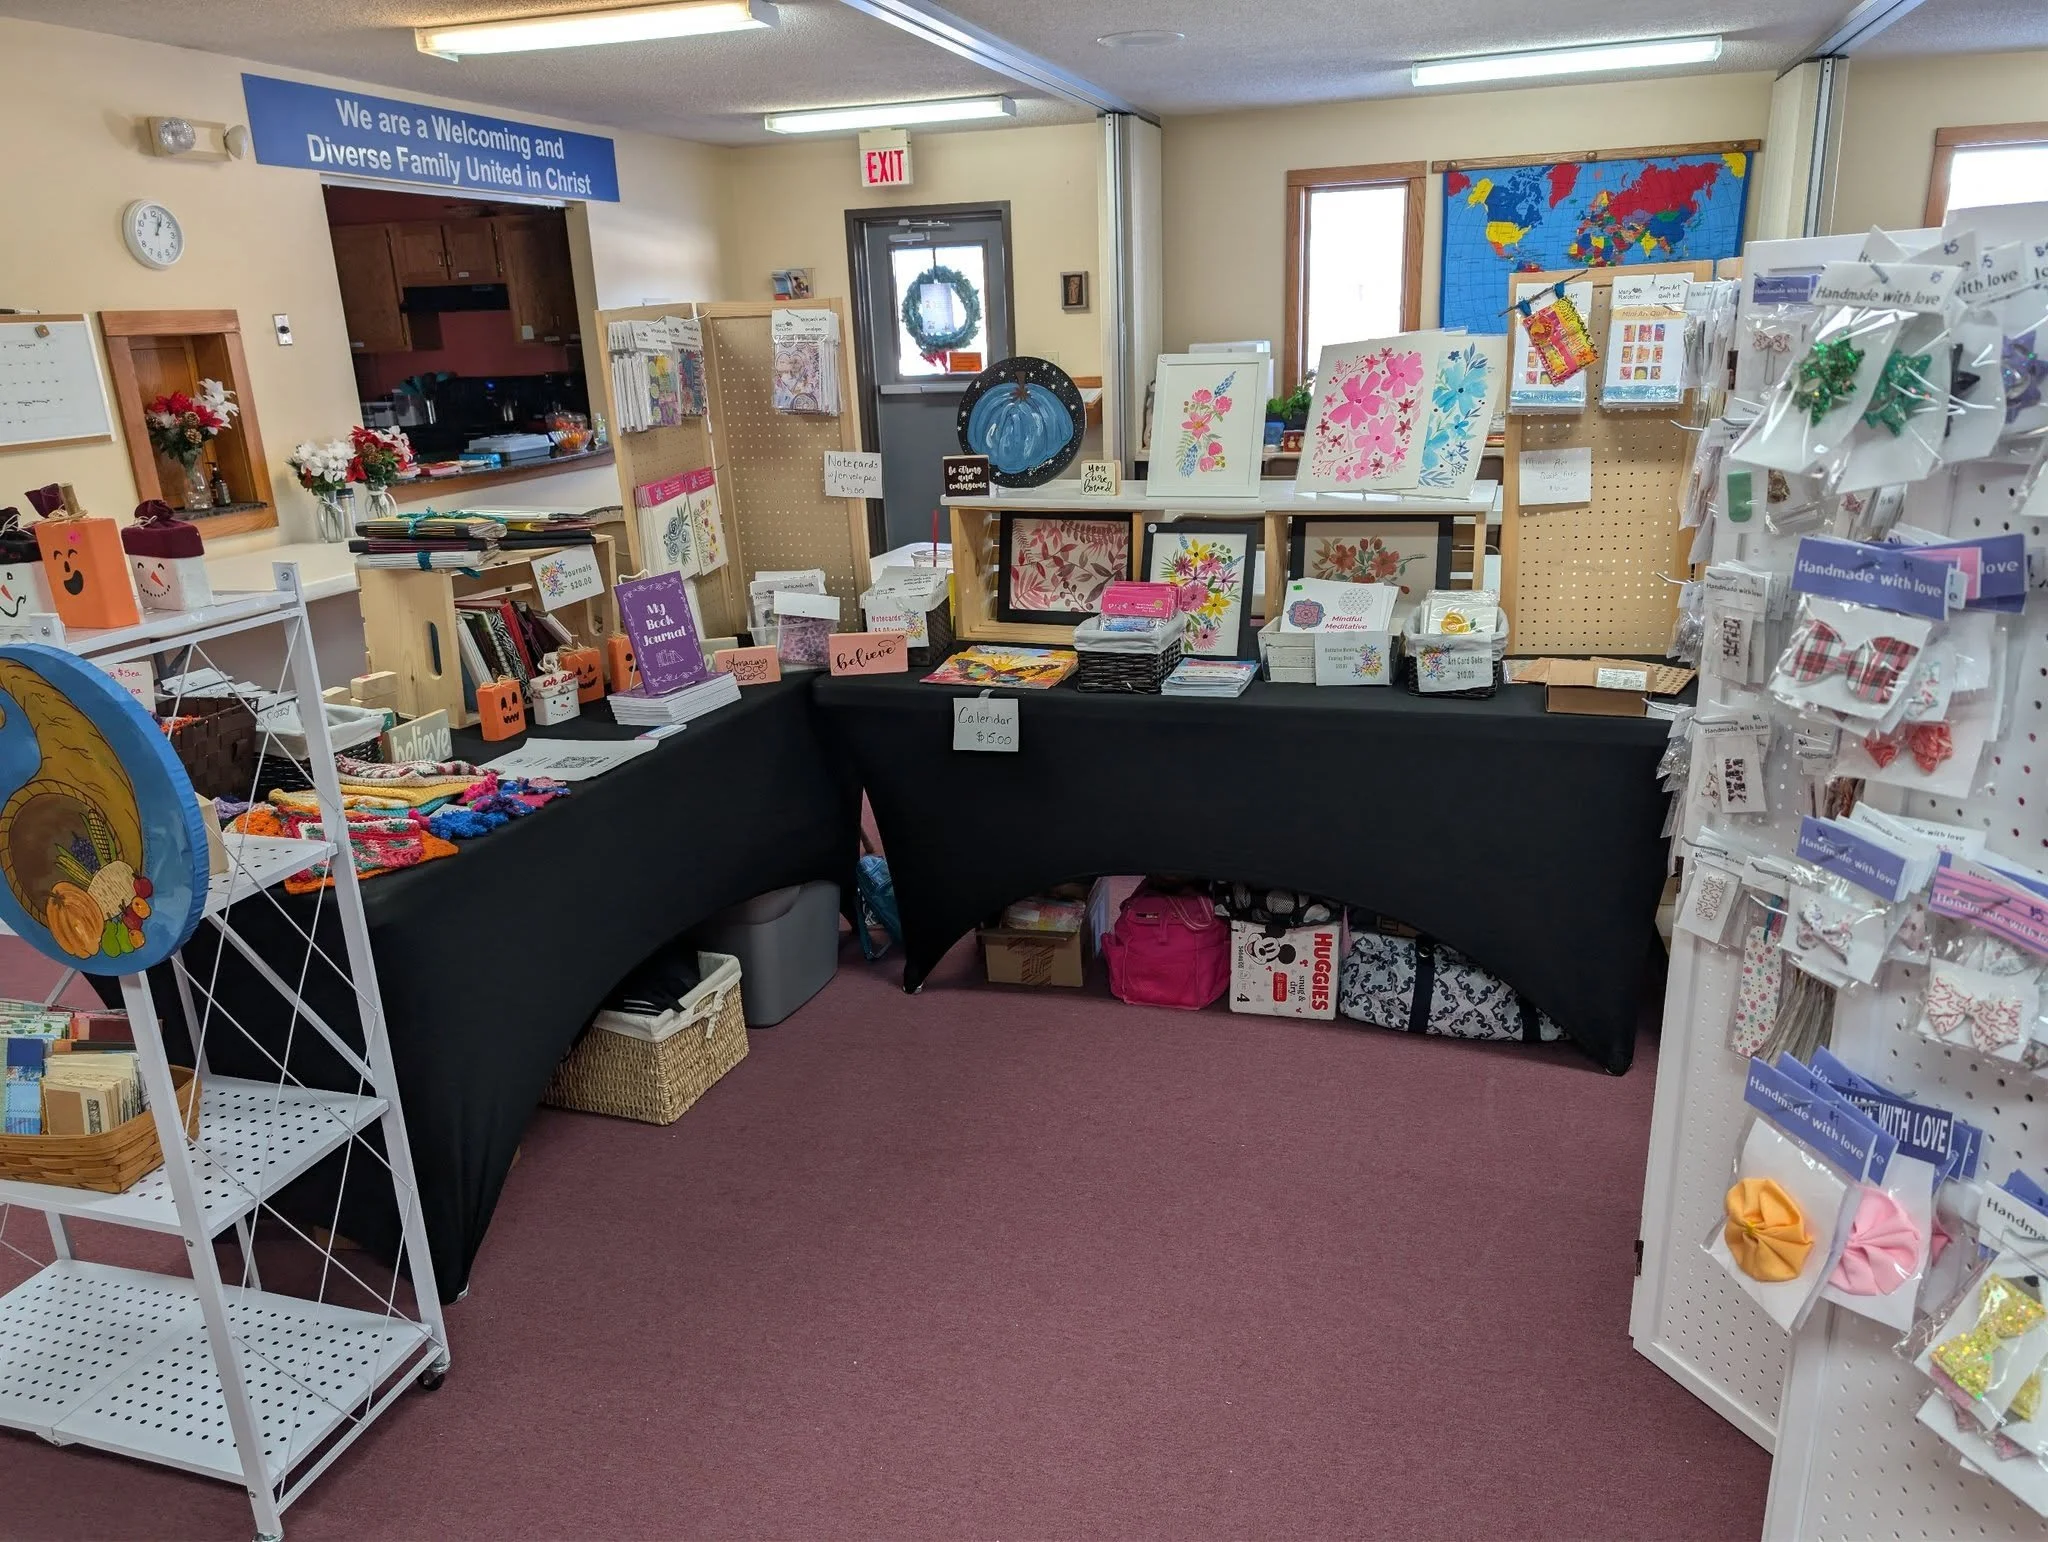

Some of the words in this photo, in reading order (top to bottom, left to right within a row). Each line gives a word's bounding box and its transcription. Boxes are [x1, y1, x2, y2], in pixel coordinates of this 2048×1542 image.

[336, 98, 373, 130] We
[378, 111, 411, 137] are
[416, 118, 428, 139] a
[430, 114, 531, 160] Welcoming
[535, 137, 565, 160] and
[306, 133, 392, 171] Diverse
[396, 145, 460, 185] Family
[466, 160, 521, 187] United
[526, 171, 540, 189] in
[545, 169, 593, 195] Christ
[867, 150, 904, 184] EXIT
[150, 210, 157, 218] 12
[166, 221, 172, 229] 2
[170, 232, 176, 240] 3
[1987, 270, 2018, 287] love
[1816, 286, 1879, 303] Handmade
[1883, 290, 1907, 304] with
[1914, 293, 1941, 305] love
[828, 454, 879, 470] Notecards
[1088, 464, 1106, 474] you
[957, 472, 975, 482] and
[958, 465, 982, 477] strong
[949, 481, 987, 491] courageous
[564, 564, 593, 579] Journals
[1981, 559, 2019, 575] love
[571, 577, 593, 590] $20.00
[1798, 559, 1875, 584] Handmade
[1880, 573, 1912, 590] with
[1914, 578, 1943, 598] love
[1706, 583, 1738, 593] Handmade
[1739, 587, 1752, 595] with
[1752, 589, 1763, 597] love
[645, 602, 667, 616] My
[645, 614, 675, 630] Book
[871, 614, 902, 623] Notecards
[642, 625, 687, 647] Journal
[834, 633, 905, 673] believe
[1448, 657, 1456, 665] Art
[1457, 656, 1470, 665] Card
[1471, 656, 1483, 664] Sets
[726, 653, 768, 671] Amazing
[543, 676, 558, 688] oh
[1457, 670, 1475, 679] $10.00
[958, 706, 1013, 725] Calendar
[1705, 725, 1738, 734] Handmade
[1739, 724, 1754, 732] with
[1754, 723, 1768, 731] love
[393, 725, 451, 764] believe
[976, 730, 1012, 745] $15.00
[1861, 814, 1893, 839] Handmade
[1927, 827, 1946, 838] with
[1946, 831, 1966, 842] love
[1801, 835, 1852, 864] Handmade
[1854, 860, 1875, 877] with
[1876, 867, 1897, 886] love
[1935, 893, 2004, 922] Handmade
[2009, 918, 2034, 937] with
[1311, 932, 1334, 1011] HUGGIES
[1288, 981, 1298, 996] dry
[1297, 975, 1305, 996] snug
[1237, 993, 1250, 1003] 4
[1750, 1075, 1809, 1121] Handmade
[1812, 1117, 1839, 1141] with
[1840, 1133, 1865, 1160] love
[1878, 1103, 1910, 1143] WITH
[1912, 1110, 1949, 1154] LOVE
